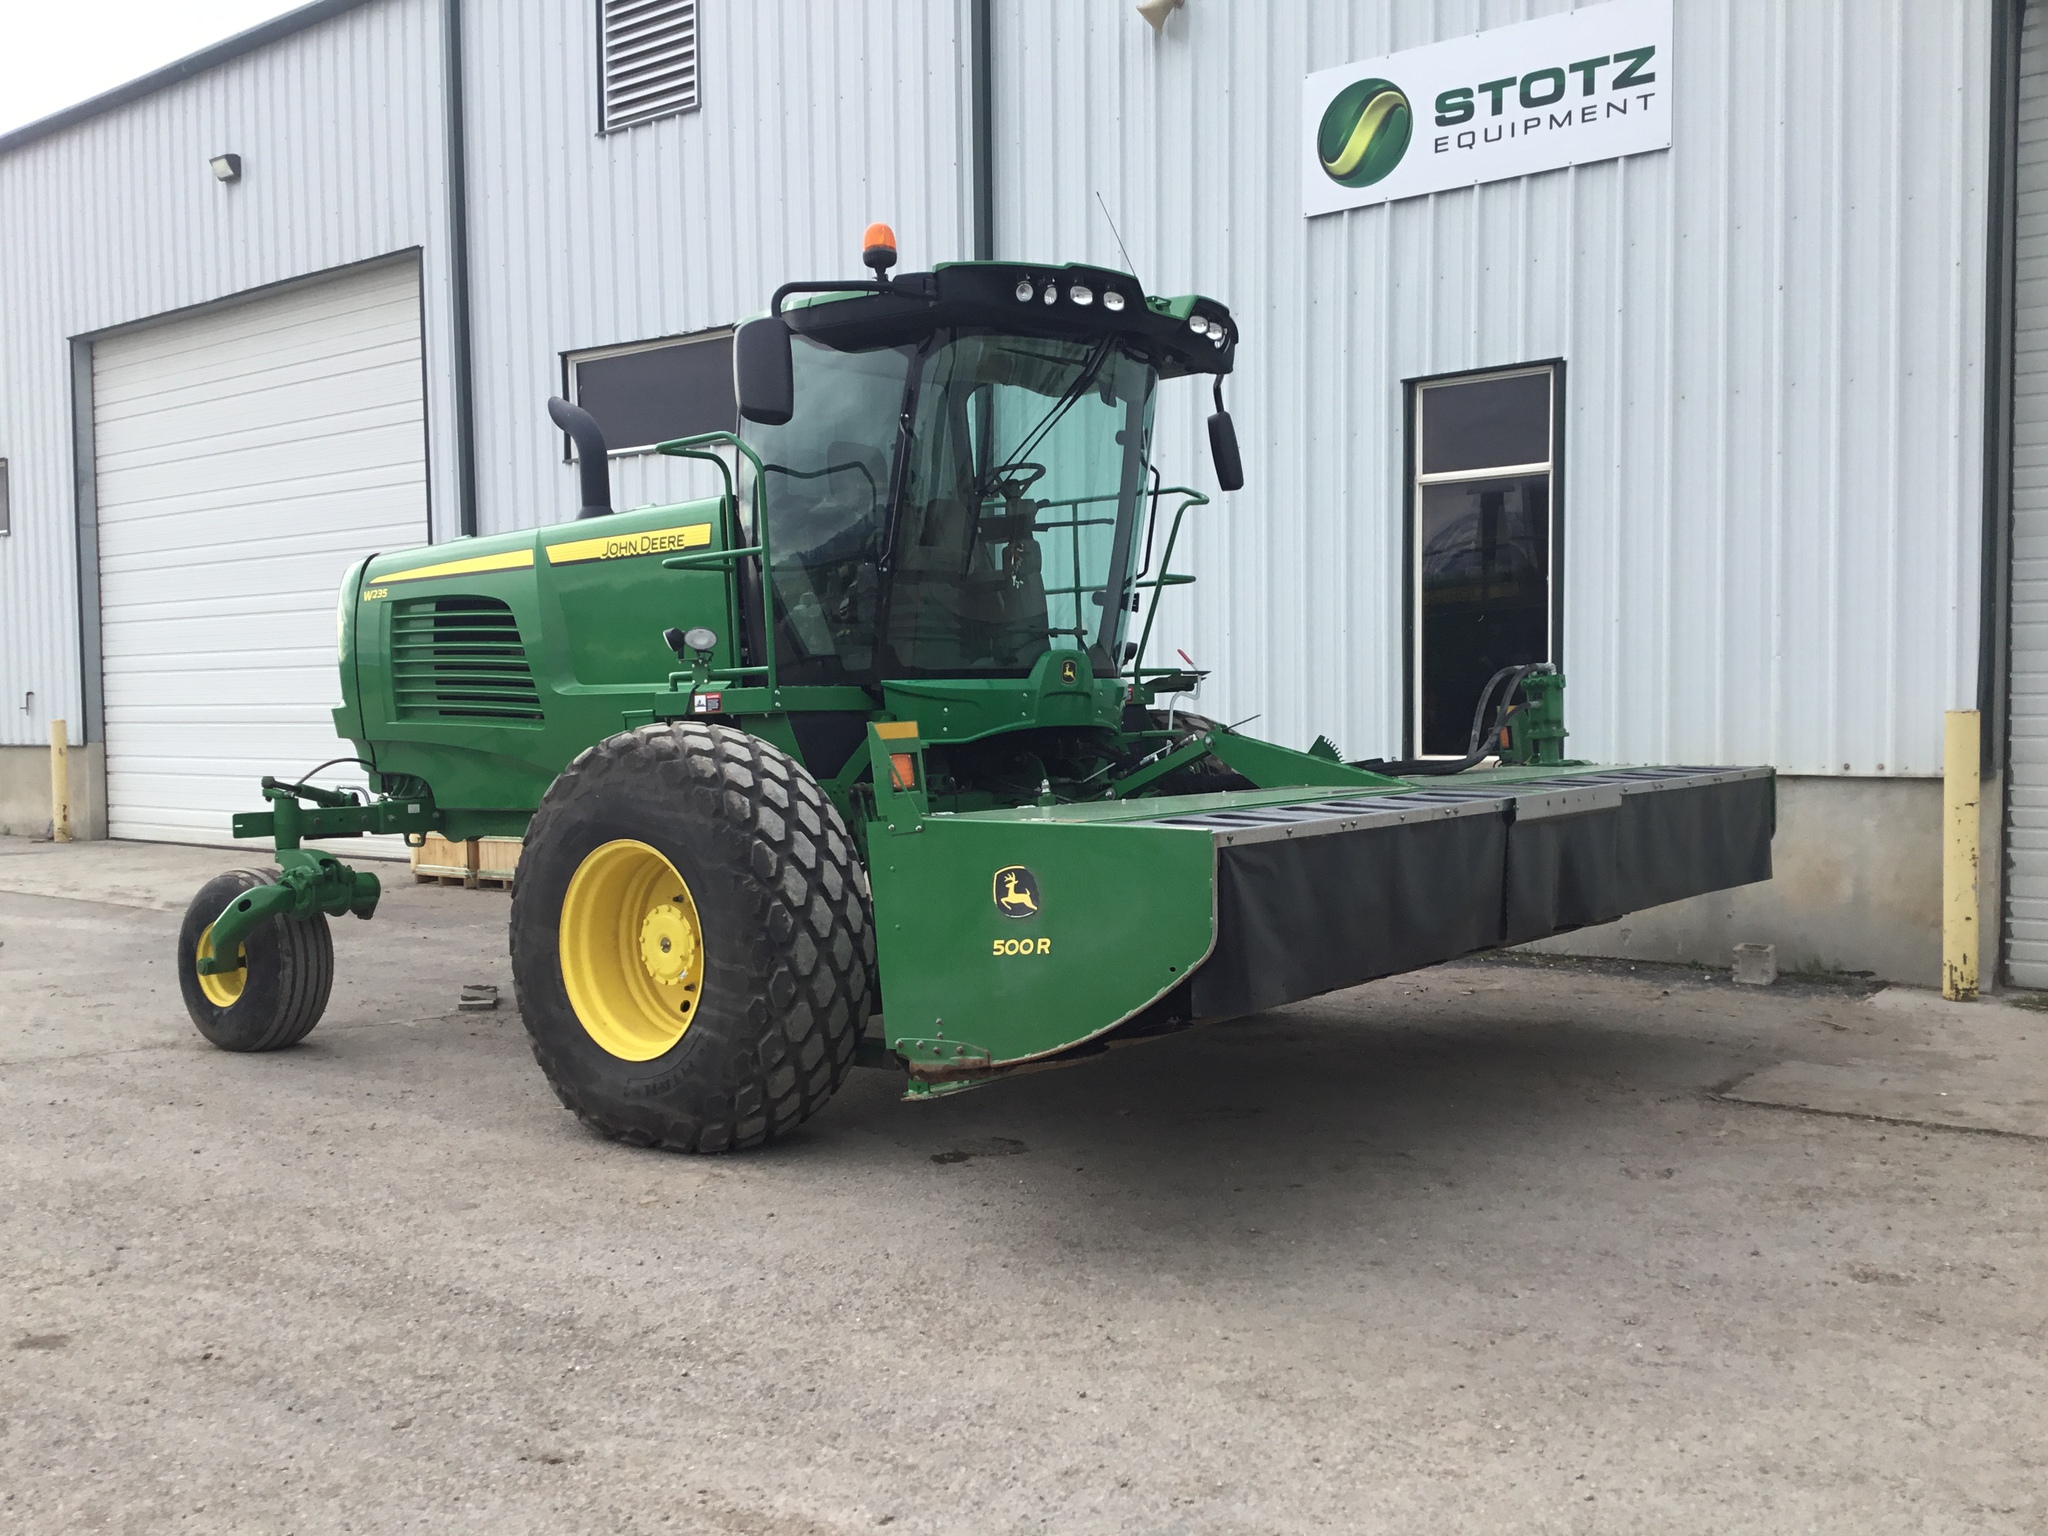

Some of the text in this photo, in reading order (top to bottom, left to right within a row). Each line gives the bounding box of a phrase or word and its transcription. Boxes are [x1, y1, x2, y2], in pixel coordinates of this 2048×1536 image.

[1435, 45, 1656, 127] STOTZ
[1435, 93, 1656, 154] EQUIPMENT
[602, 534, 685, 557] JOHN DEERE
[363, 588, 388, 601] W235
